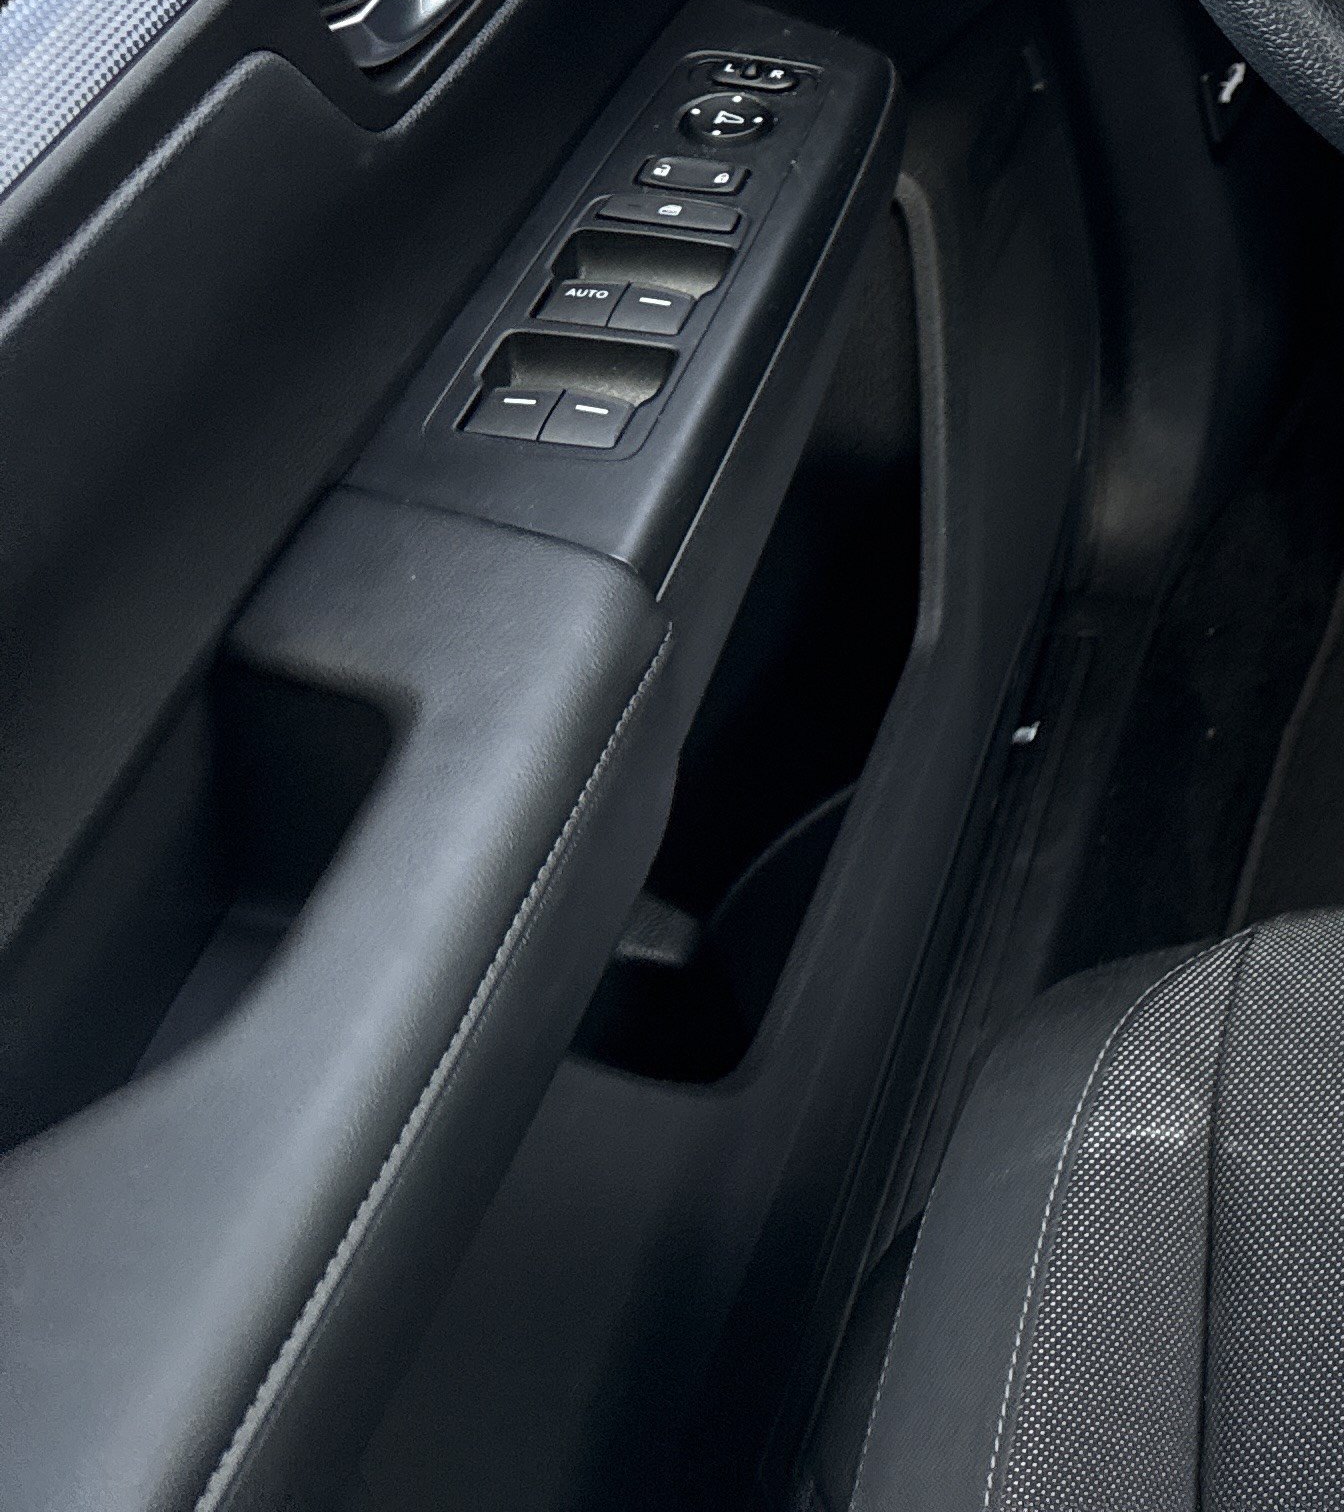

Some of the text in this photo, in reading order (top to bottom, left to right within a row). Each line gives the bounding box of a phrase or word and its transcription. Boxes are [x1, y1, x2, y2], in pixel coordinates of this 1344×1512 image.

[724, 63, 735, 73] L
[770, 68, 785, 79] R
[565, 288, 609, 299] AUTO
